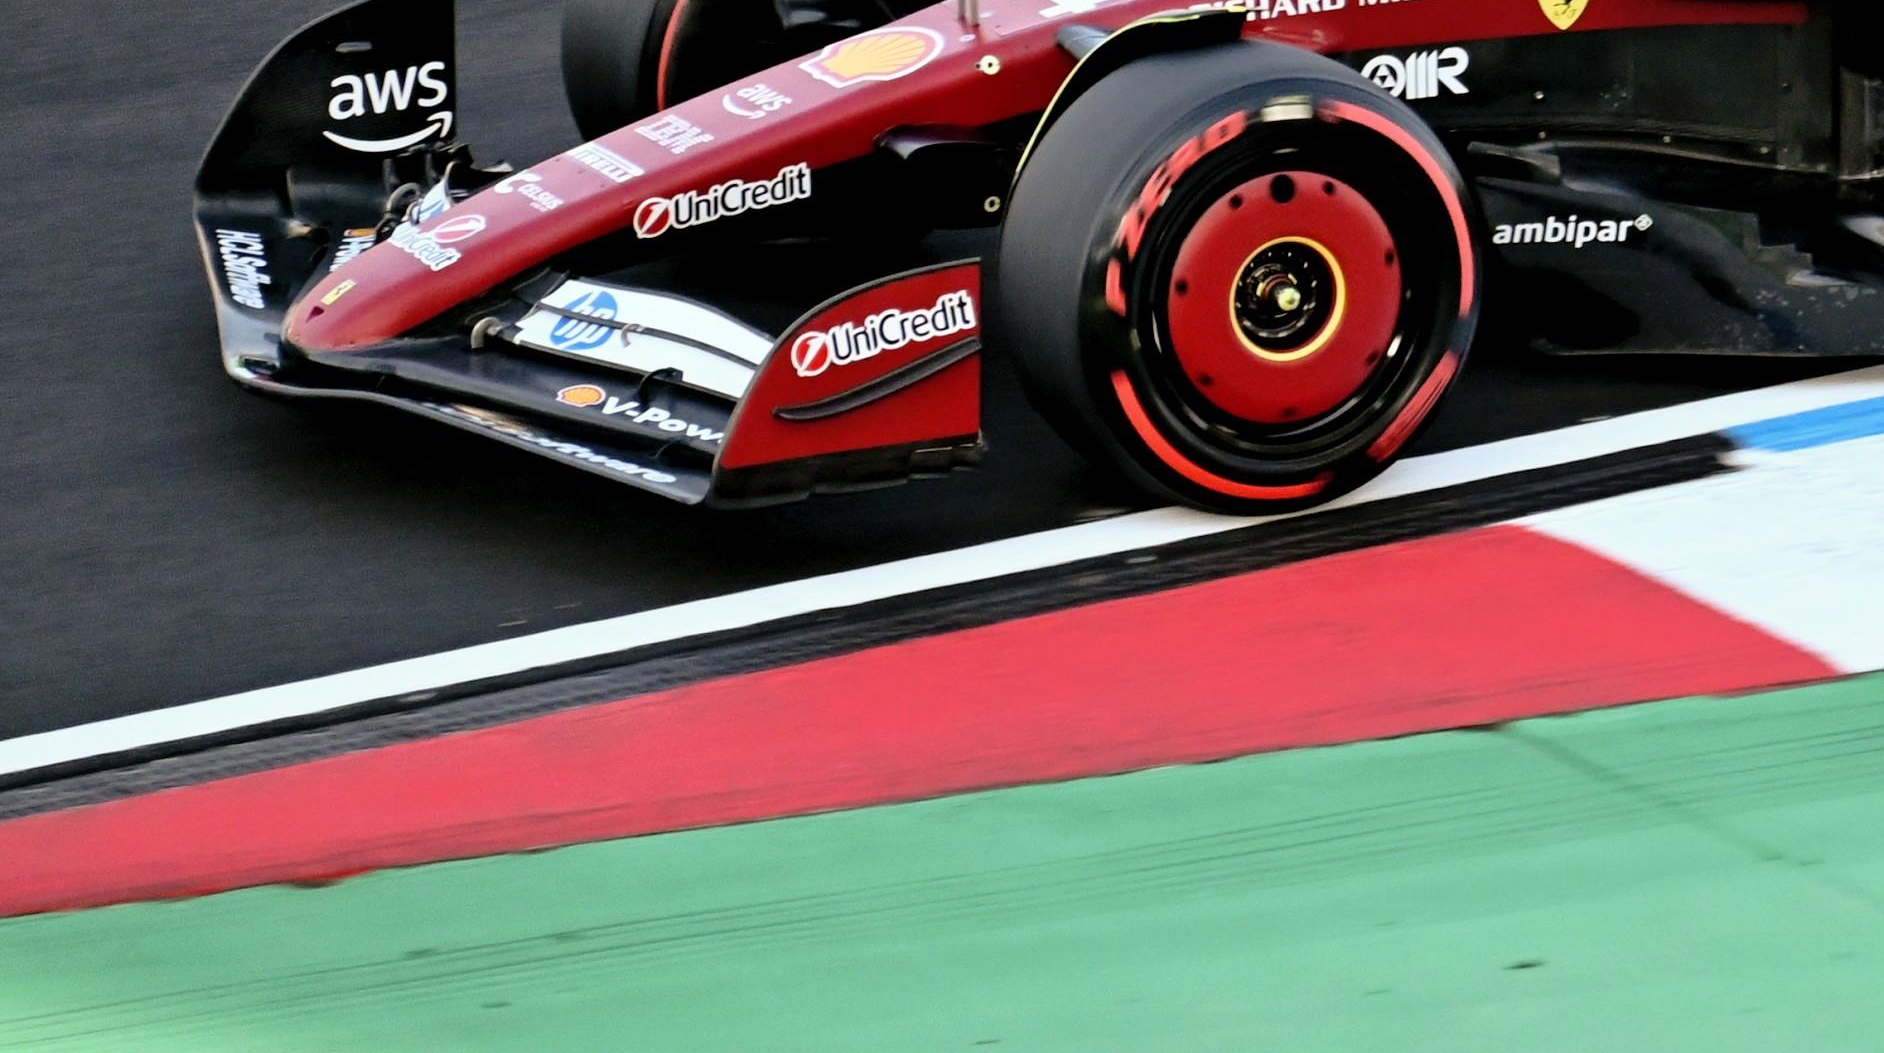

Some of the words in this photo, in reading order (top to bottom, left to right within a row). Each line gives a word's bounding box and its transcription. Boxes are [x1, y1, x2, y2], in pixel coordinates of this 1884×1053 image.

[327, 60, 448, 121] aws
[735, 84, 793, 112] aws
[673, 166, 810, 224] UniCredit
[1492, 214, 1634, 249] ambipar
[830, 294, 971, 362] UniCredit
[601, 397, 725, 445] V-Pow
